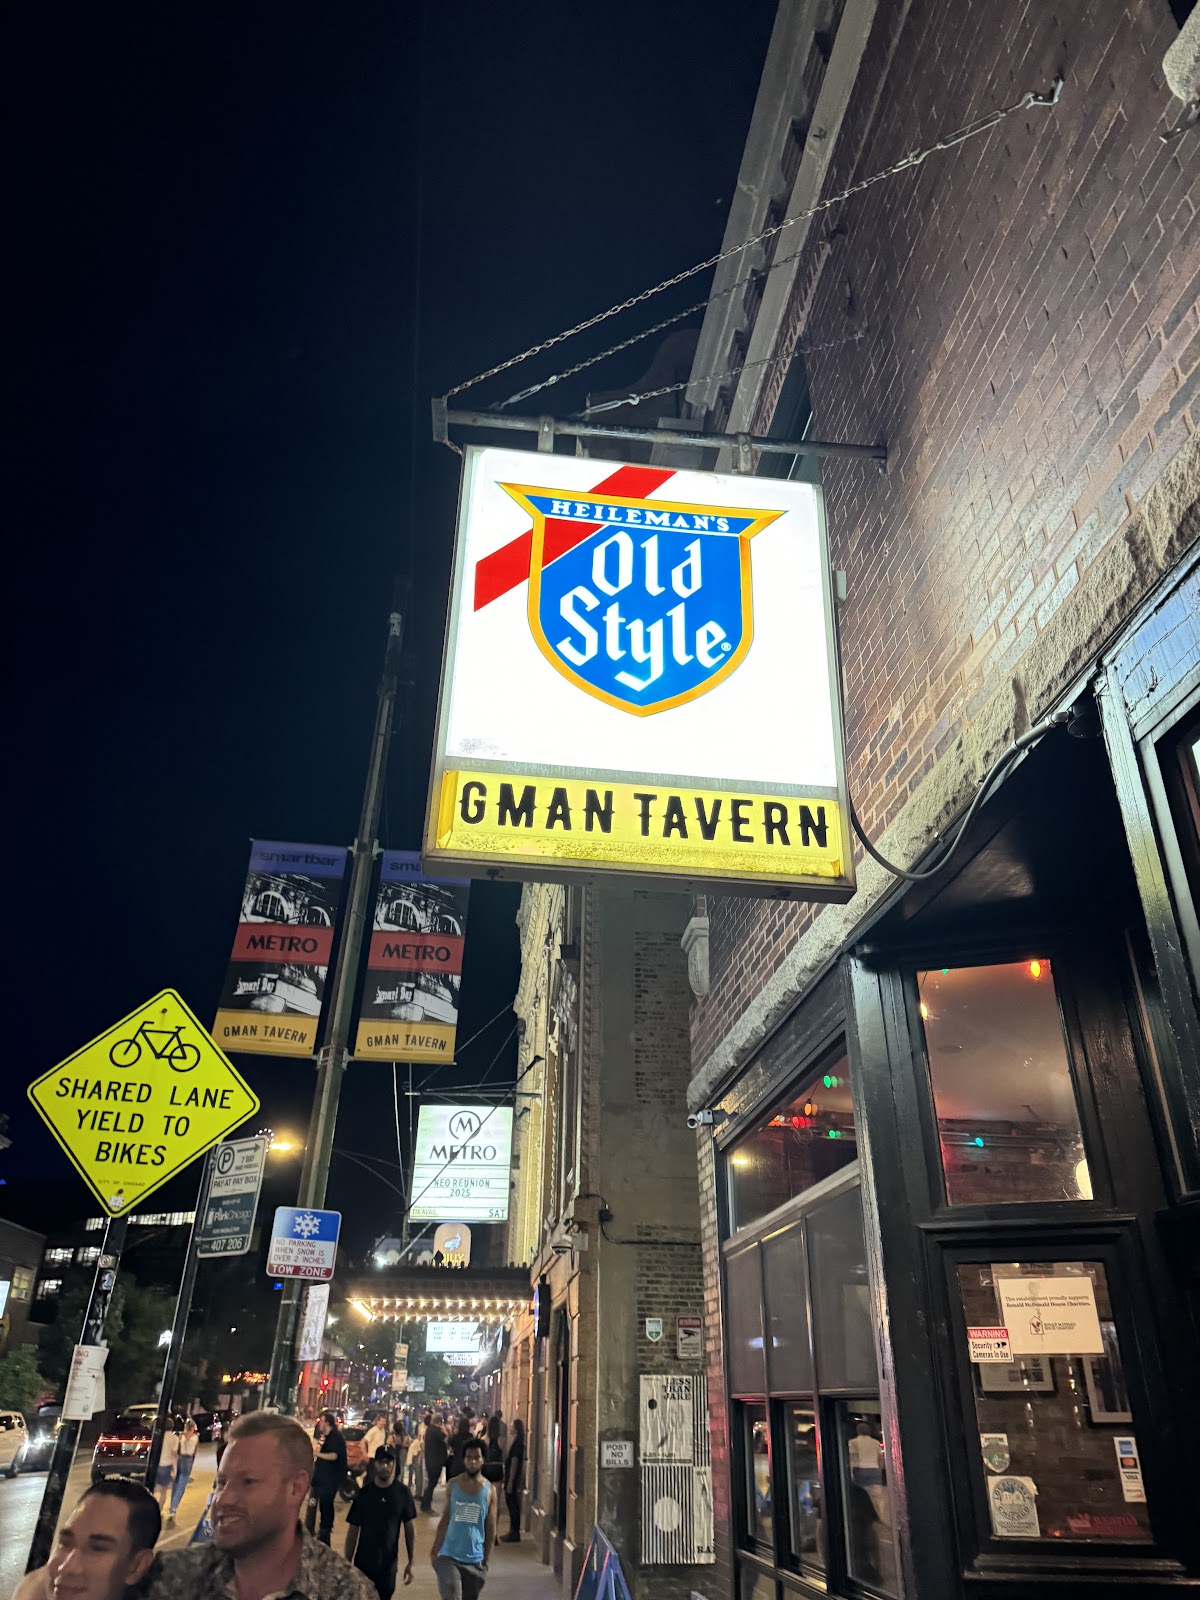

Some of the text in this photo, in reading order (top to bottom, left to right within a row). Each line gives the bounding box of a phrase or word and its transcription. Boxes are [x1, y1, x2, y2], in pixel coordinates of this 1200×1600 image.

[551, 500, 730, 533] HEILEMAN'S
[591, 531, 703, 599] Old
[556, 585, 727, 692] Style
[458, 781, 830, 848] GMAN TAVERN
[259, 851, 340, 867] smartbar
[246, 935, 319, 954] METRO
[382, 943, 451, 962] METRO
[223, 1025, 308, 1044] GMAN TAVERN
[366, 1034, 447, 1051] GMAN TAVERN
[55, 1077, 235, 1110] SHARED LANE
[77, 1109, 191, 1137] YIELD TO
[94, 1141, 168, 1166] BIKES
[429, 1144, 497, 1161] METRO
[213, 1175, 257, 1188] PAY AT PAY BOX
[434, 1178, 490, 1189] NEO REUNION
[449, 1188, 471, 1198] 2025
[488, 1208, 506, 1219] SAT
[210, 1240, 226, 1251] 407
[226, 1237, 243, 1250] 206
[289, 1240, 316, 1248] PARKING
[275, 1246, 294, 1254] WHEN
[297, 1248, 316, 1256] SNOW
[273, 1253, 326, 1265] OVER 2 INCHES
[272, 1264, 327, 1277] TOW ZONE
[969, 1329, 1008, 1339] WARNING
[972, 1341, 992, 1350] Security
[972, 1350, 994, 1359] Cameras
[999, 1350, 1009, 1359] Use
[666, 1377, 691, 1386] LESS
[662, 1384, 691, 1393] THAN
[663, 1392, 691, 1400] JAKE
[605, 1458, 629, 1466] BILLS
